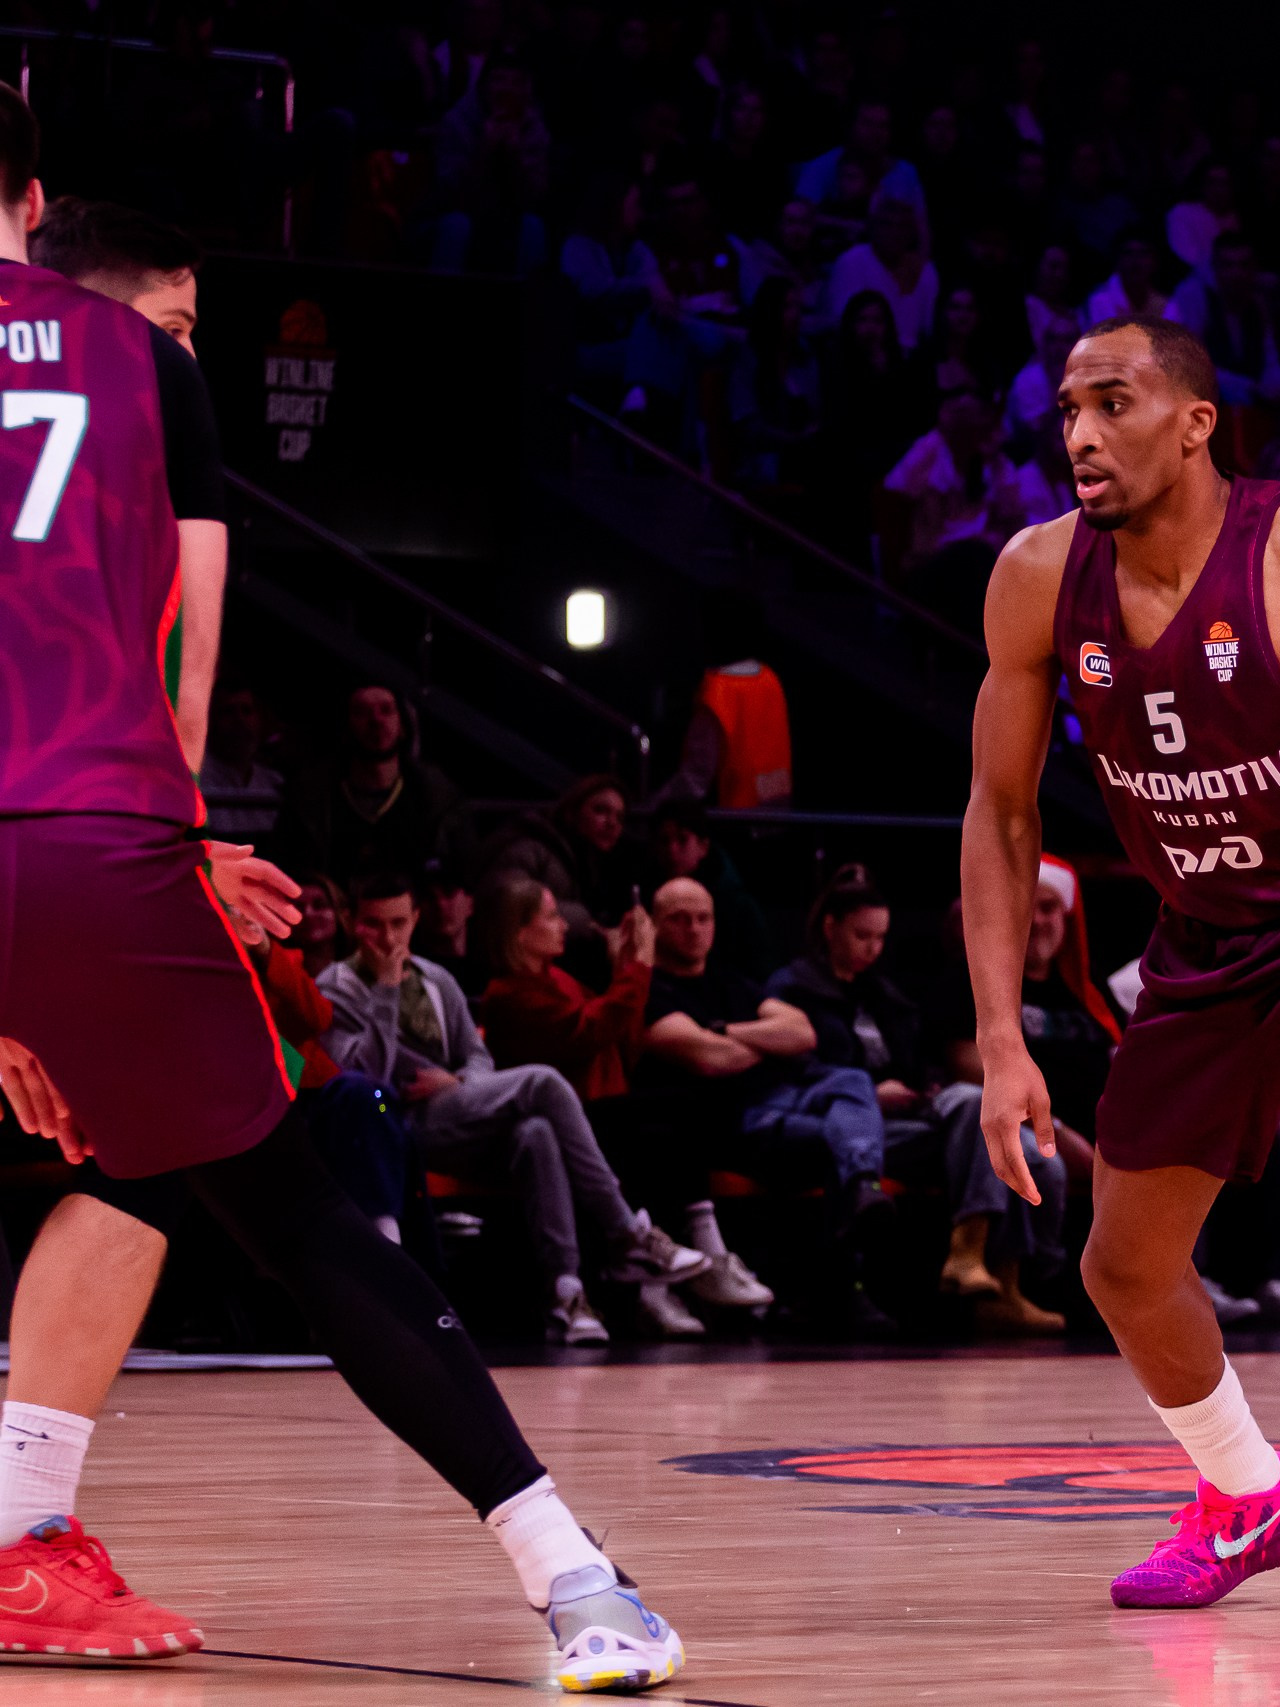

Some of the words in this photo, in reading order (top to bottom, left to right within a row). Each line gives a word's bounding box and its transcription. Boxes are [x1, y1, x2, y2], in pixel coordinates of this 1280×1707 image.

[0, 320, 61, 362] OV
[2, 390, 89, 542] 7
[1204, 641, 1240, 657] WINLINE
[1208, 655, 1238, 670] BASKET
[1217, 669, 1233, 682] CUP
[1144, 691, 1187, 754] 5
[1152, 810, 1237, 826] KUBAN
